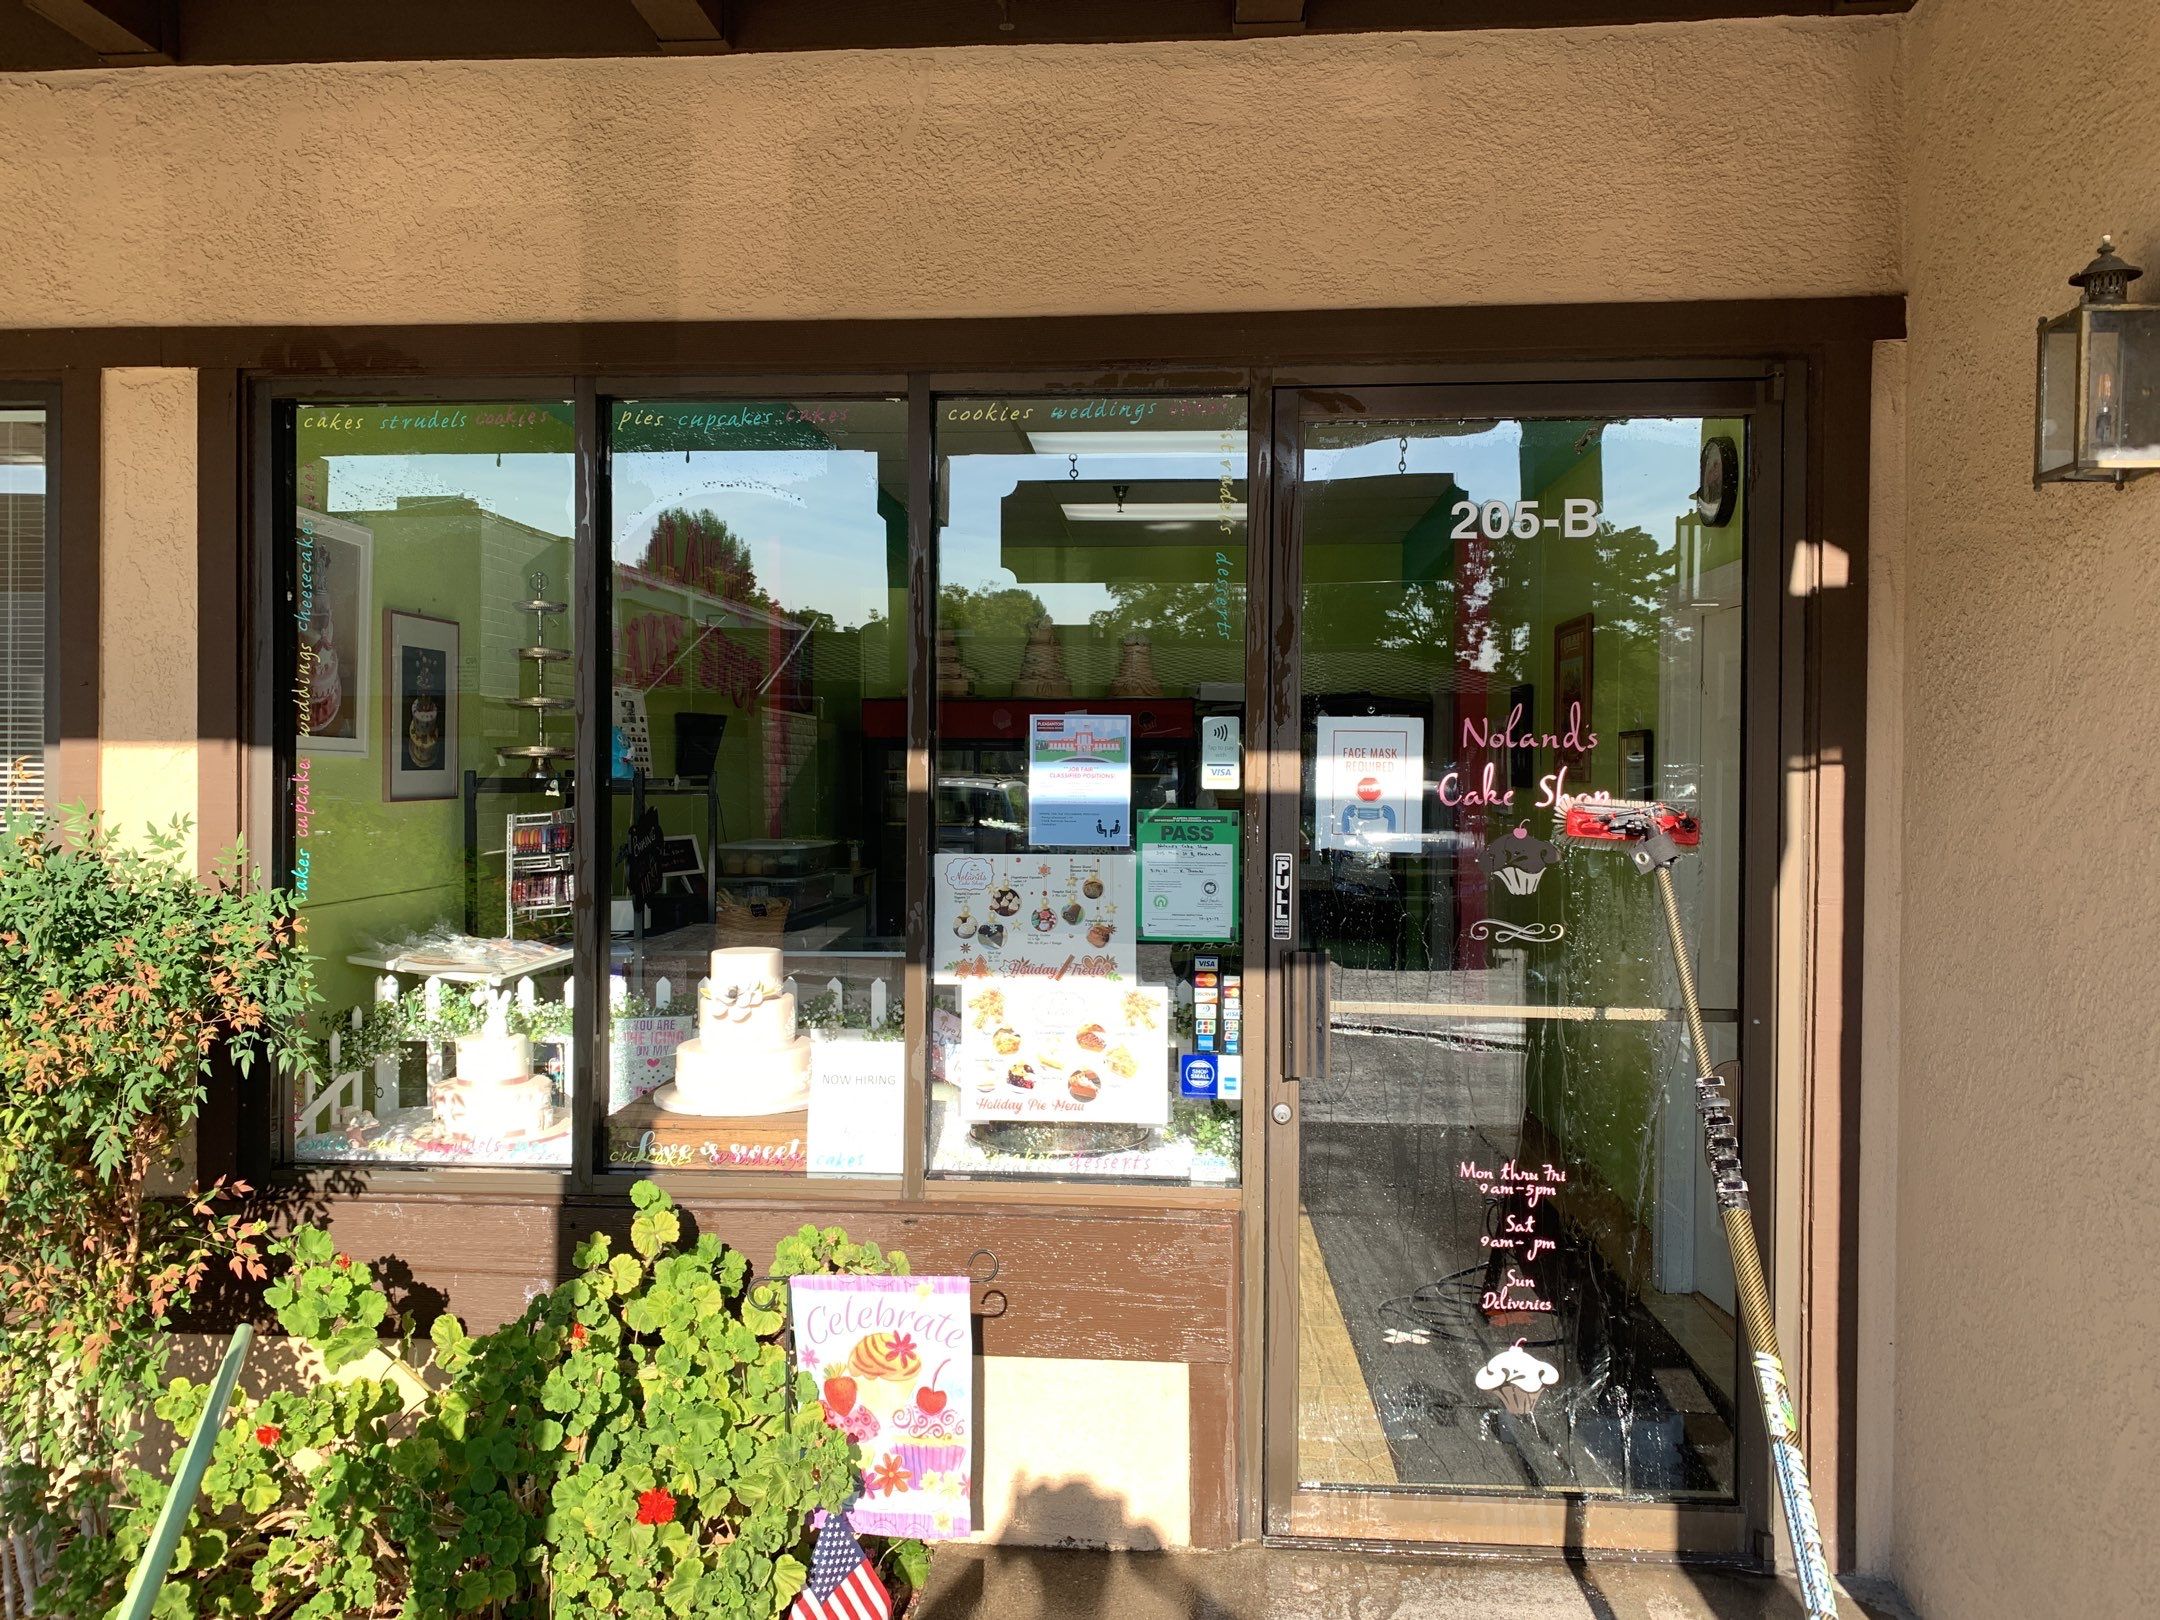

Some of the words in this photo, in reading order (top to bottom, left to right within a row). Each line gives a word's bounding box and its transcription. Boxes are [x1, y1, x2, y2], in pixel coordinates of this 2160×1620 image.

[303, 412, 364, 430] cakes
[380, 410, 467, 429] strudels
[475, 405, 549, 425] cookies
[617, 409, 664, 432] pies
[678, 407, 773, 434] cupcakes
[785, 404, 849, 423] cakes
[948, 403, 1034, 421] cookies
[1051, 400, 1157, 424] weddings
[1450, 498, 1599, 540] 205-B
[294, 519, 314, 632] cheesecakes
[1215, 552, 1233, 639] desserts
[292, 643, 321, 737] weddings
[1463, 701, 1599, 752] Noland's
[1343, 747, 1367, 759] FACE
[1370, 747, 1398, 759] MASK
[1211, 768, 1231, 776] VISA
[1345, 761, 1395, 773] REQUIRED
[1437, 762, 1515, 807] Cake
[292, 757, 315, 837] cupcakes
[1161, 825, 1215, 841] PASS
[1275, 860, 1290, 919] PULL
[1008, 959, 1058, 978] Holiday
[1070, 962, 1106, 977] Treats
[634, 1019, 653, 1030] YOU
[657, 1019, 676, 1030] ARE
[823, 1074, 851, 1085] NOW
[855, 1075, 896, 1085] HIRING
[976, 1097, 1023, 1114] Holiday
[1028, 1097, 1047, 1111] Pie
[1051, 1098, 1085, 1112] Menu
[626, 1130, 693, 1161] Love
[609, 1149, 693, 1168] cupcakes
[1068, 1147, 1151, 1171] desserts
[1460, 1161, 1493, 1179] Mon
[1501, 1159, 1539, 1181] thru
[1542, 1164, 1566, 1182] Fri
[1506, 1214, 1535, 1233] Sat
[1506, 1269, 1535, 1288] Sun
[1482, 1286, 1552, 1310] Deliveries
[807, 1295, 965, 1349] Celebrate
[1753, 1351, 1787, 1437] Mamba
